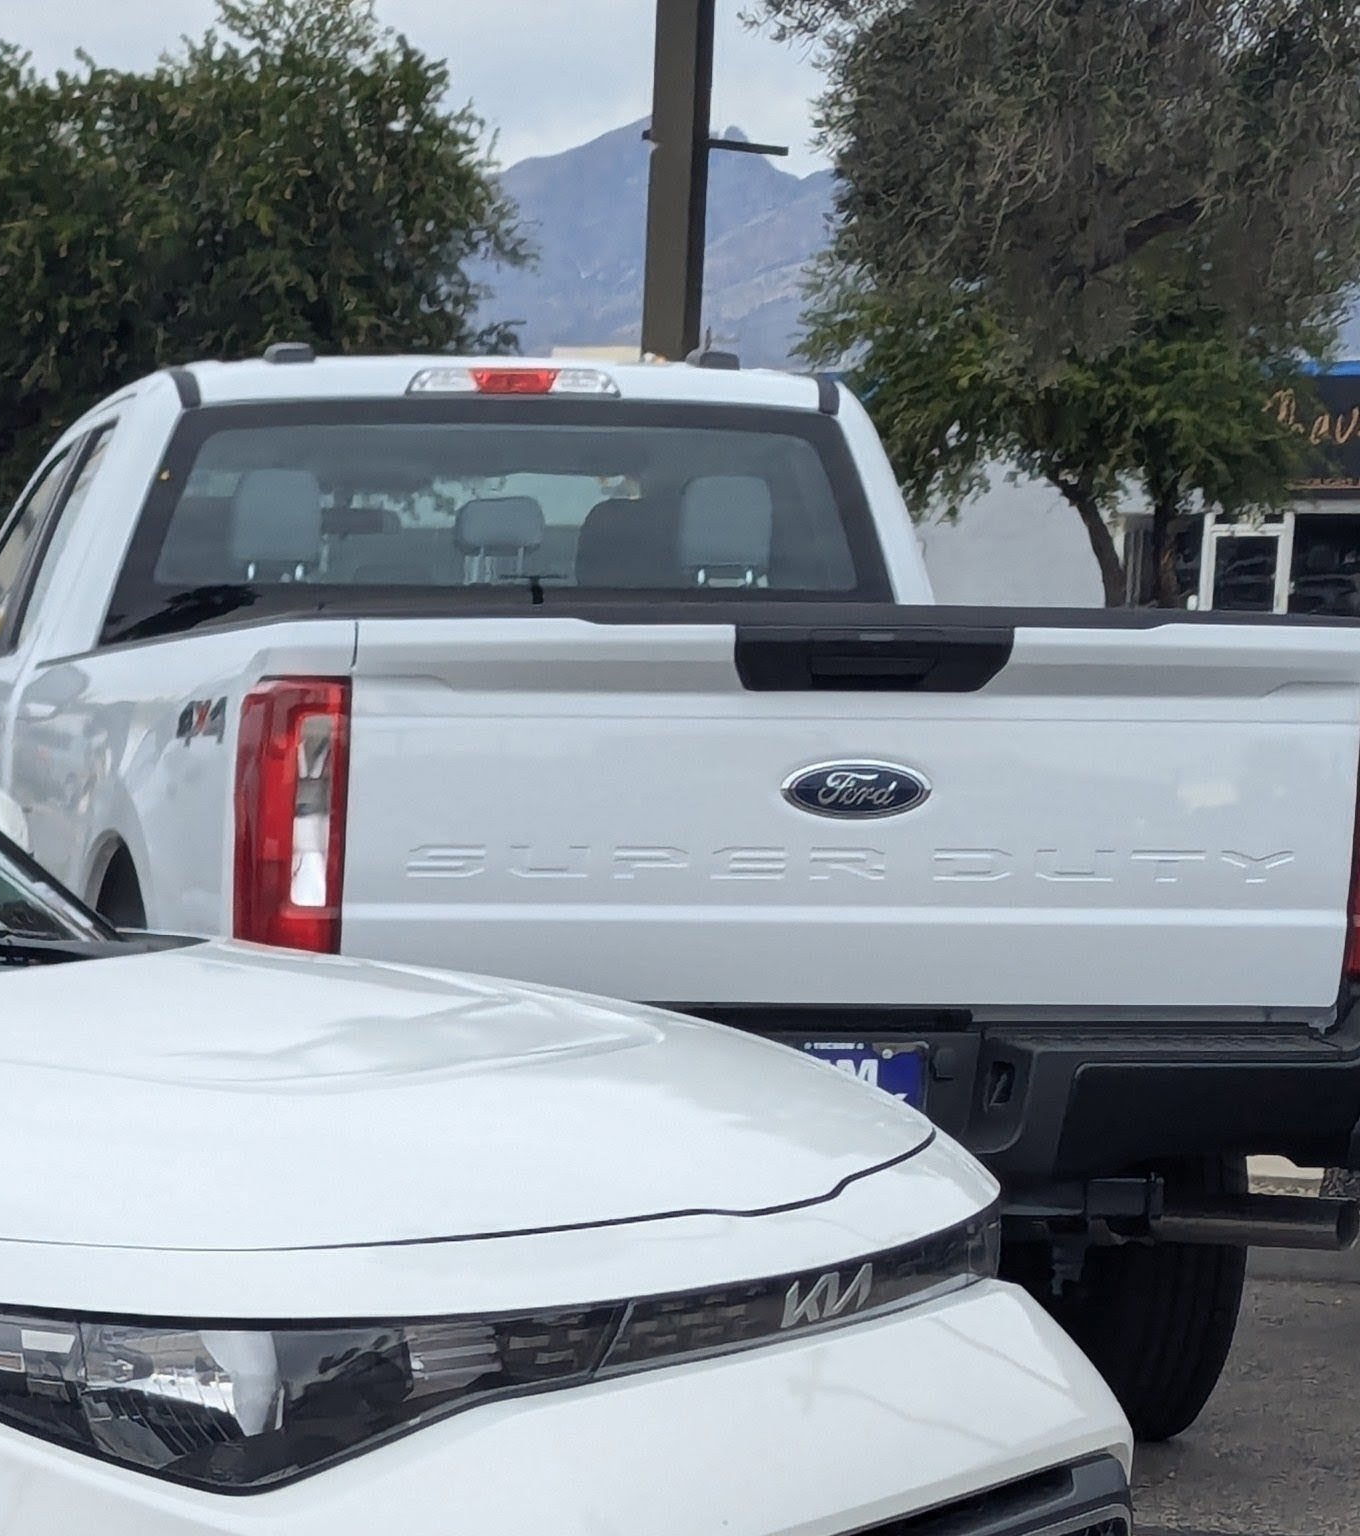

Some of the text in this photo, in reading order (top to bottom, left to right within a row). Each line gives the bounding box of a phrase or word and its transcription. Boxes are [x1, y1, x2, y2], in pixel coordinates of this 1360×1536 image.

[817, 771, 897, 806] Ford
[405, 845, 1295, 883] SUPER DUTY
[780, 1262, 874, 1329] KIA
